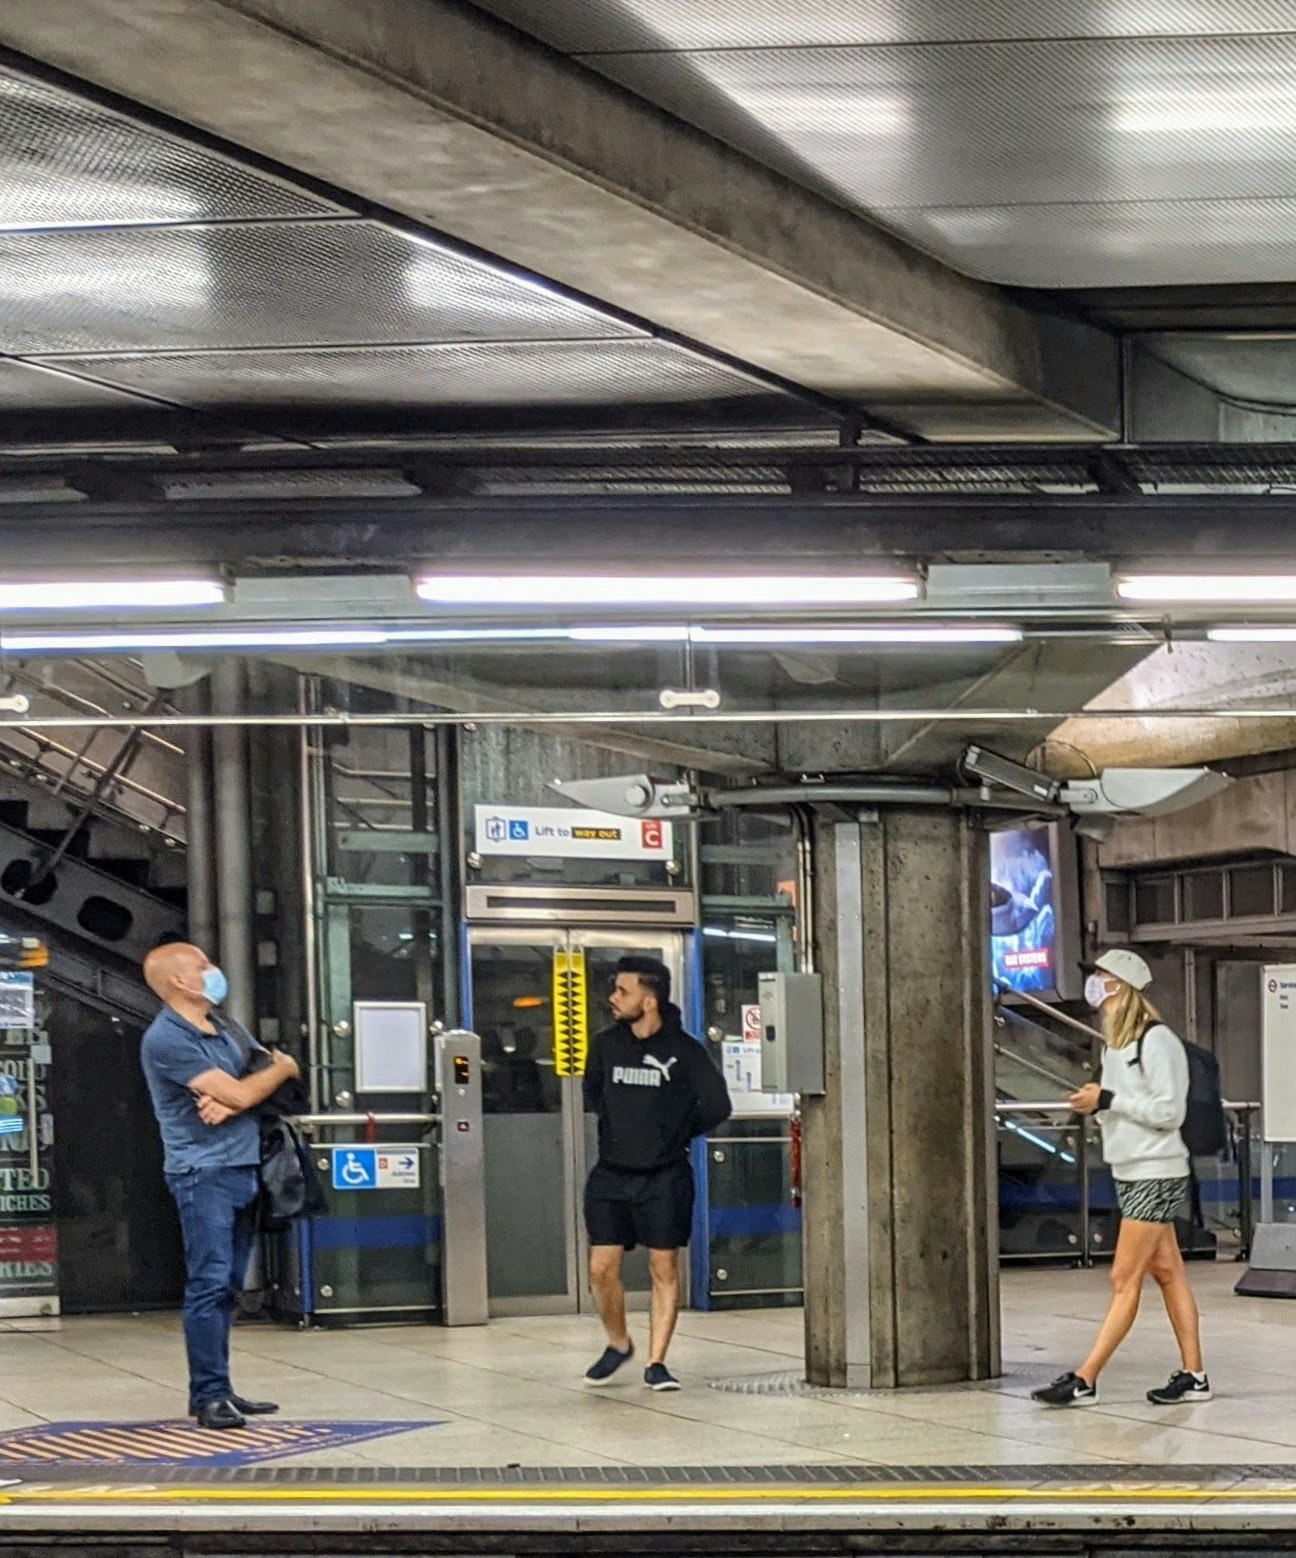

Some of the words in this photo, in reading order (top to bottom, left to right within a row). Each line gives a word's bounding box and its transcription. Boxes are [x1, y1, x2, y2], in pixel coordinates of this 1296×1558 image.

[535, 826, 555, 837] Lift
[558, 828, 569, 837] to
[574, 829, 596, 839] way
[599, 830, 618, 838] out
[645, 832, 659, 846] C
[612, 1066, 661, 1087] PUMA
